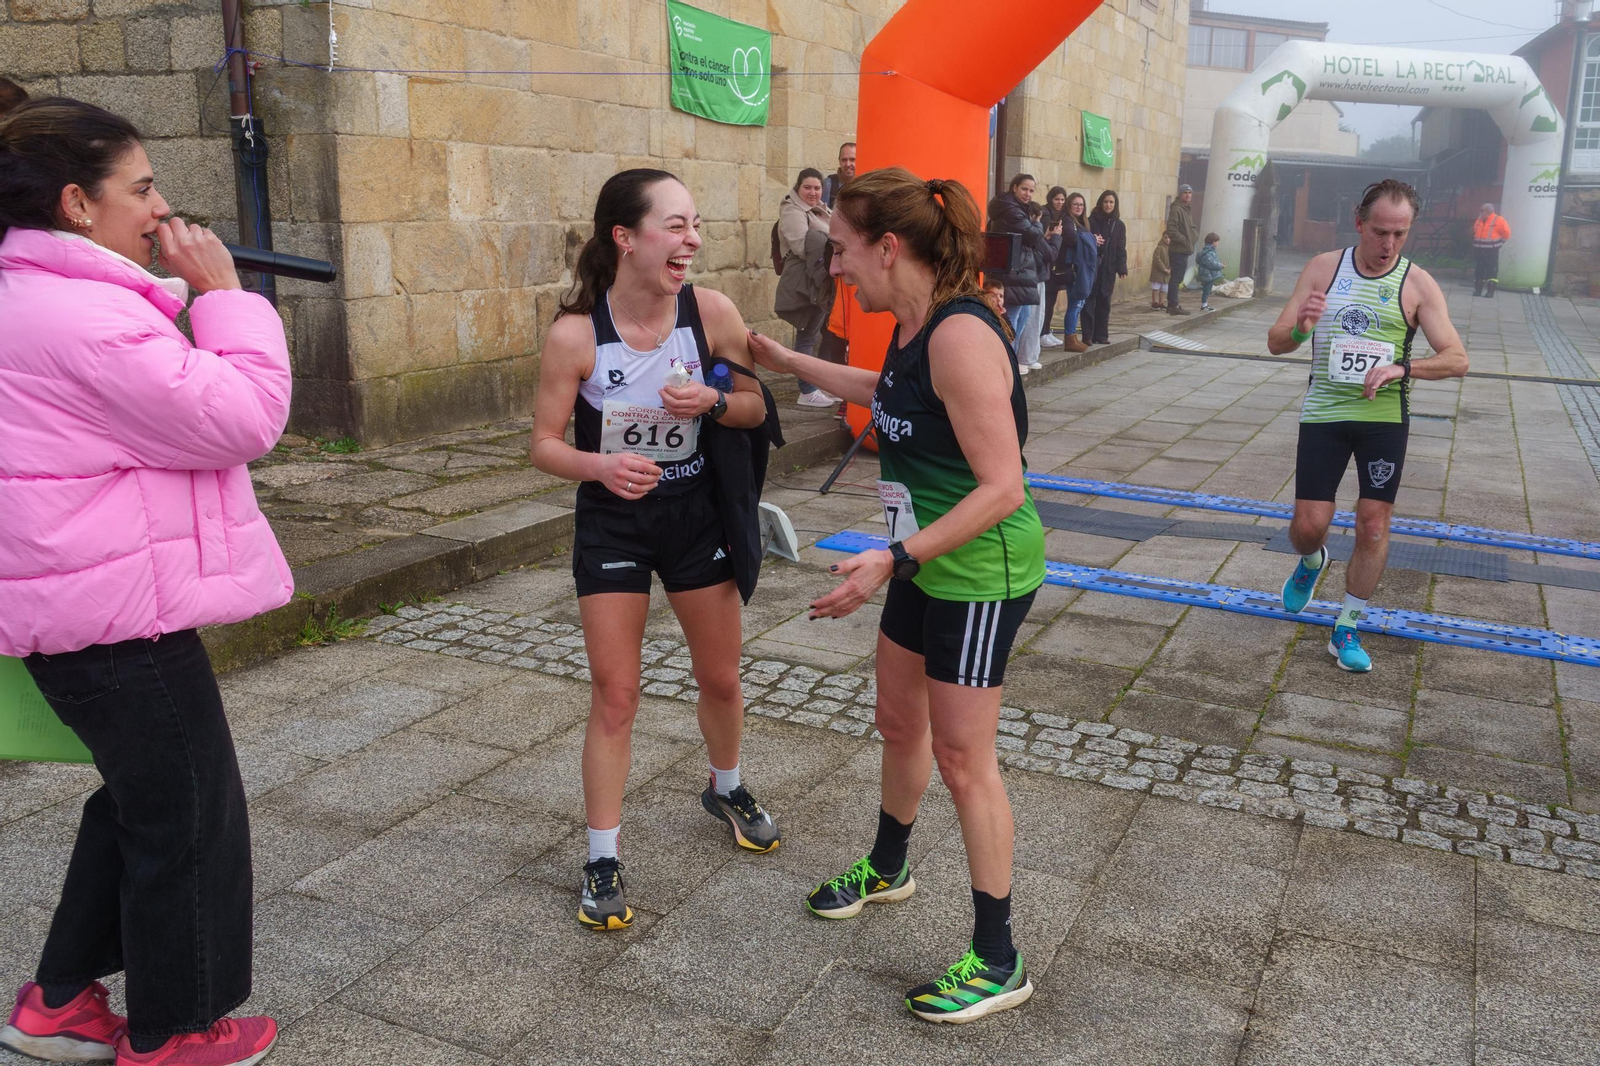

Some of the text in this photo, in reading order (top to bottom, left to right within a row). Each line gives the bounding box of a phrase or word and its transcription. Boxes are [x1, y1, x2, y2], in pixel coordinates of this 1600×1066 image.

[679, 50, 699, 66] ontra
[700, 56, 708, 69] el
[1323, 55, 1384, 77] HOTEL
[1396, 60, 1417, 80] LA
[699, 70, 714, 84] solo
[715, 76, 727, 87] uno
[1319, 78, 1430, 95] www.hotelrectoral.com
[1227, 170, 1257, 182] rode
[1341, 352, 1381, 373] 557
[611, 411, 650, 420] CONTRA
[629, 406, 671, 417] CORREM
[623, 423, 684, 449] 616
